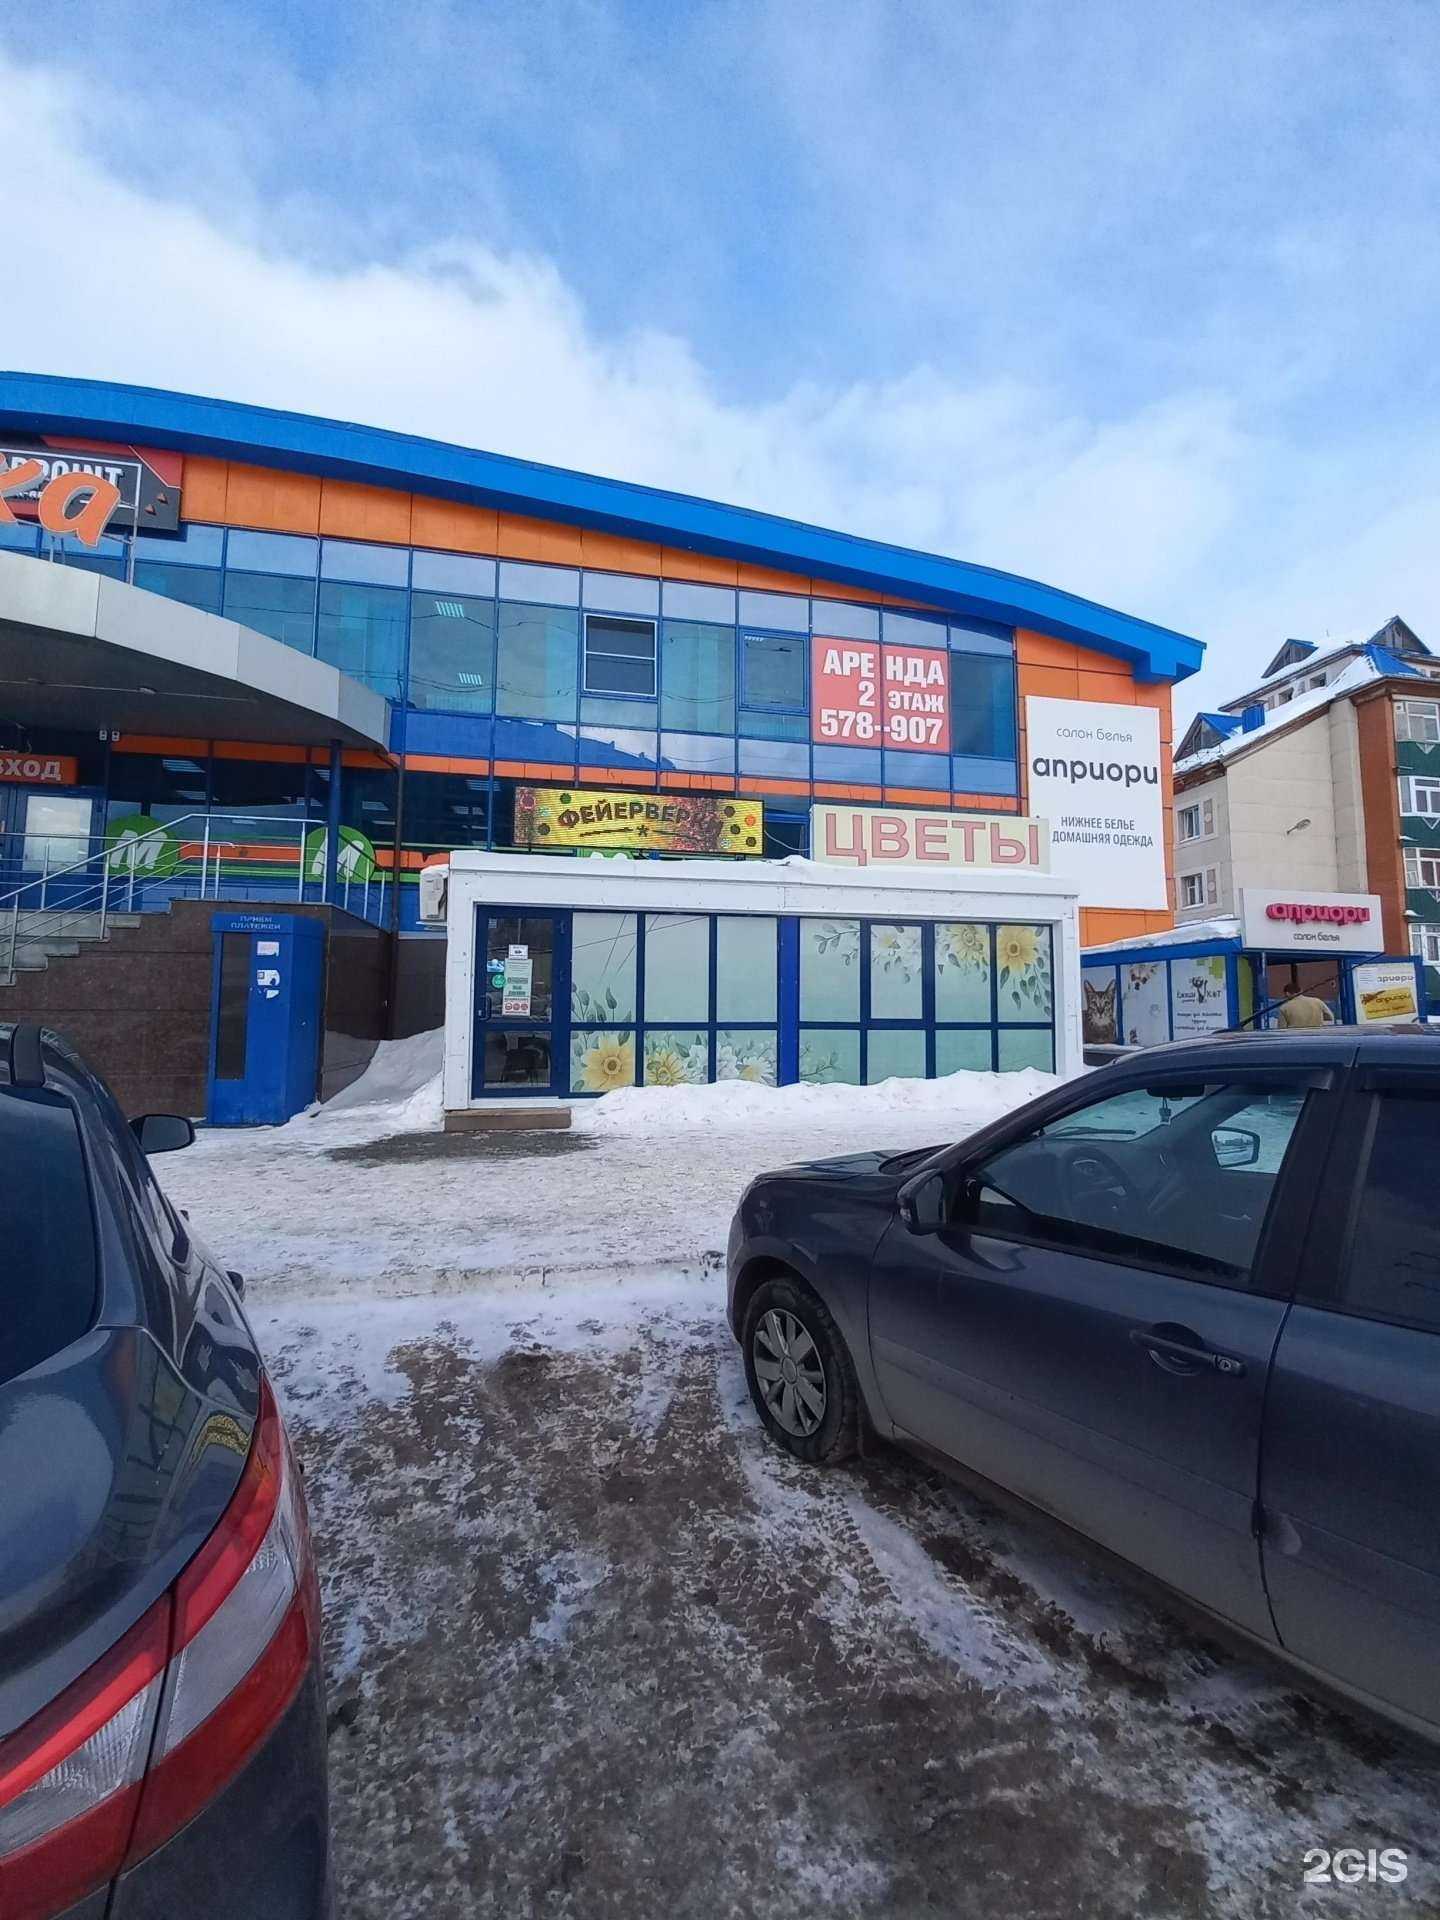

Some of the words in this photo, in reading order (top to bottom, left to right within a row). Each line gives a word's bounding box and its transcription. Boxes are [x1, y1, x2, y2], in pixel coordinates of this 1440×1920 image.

[858, 680, 876, 707] 2
[888, 690, 945, 713] ЭТАЖ
[1056, 728, 1093, 739] салон
[1097, 728, 1132, 742] белья
[0, 758, 62, 781] ХОД
[1033, 757, 1158, 788] априори
[557, 799, 706, 829] ФЕЙЕРВЕР
[1061, 816, 1102, 829] НИЖНЕЕ
[1104, 819, 1135, 831] БЕЛЬЕ
[825, 813, 1040, 866] ЦВЕТЫ
[1052, 831, 1110, 843] ДОМАШНЯЯ
[1113, 834, 1153, 847] ОДЕЖДА
[1266, 903, 1370, 926] априори
[1293, 932, 1316, 941] салон
